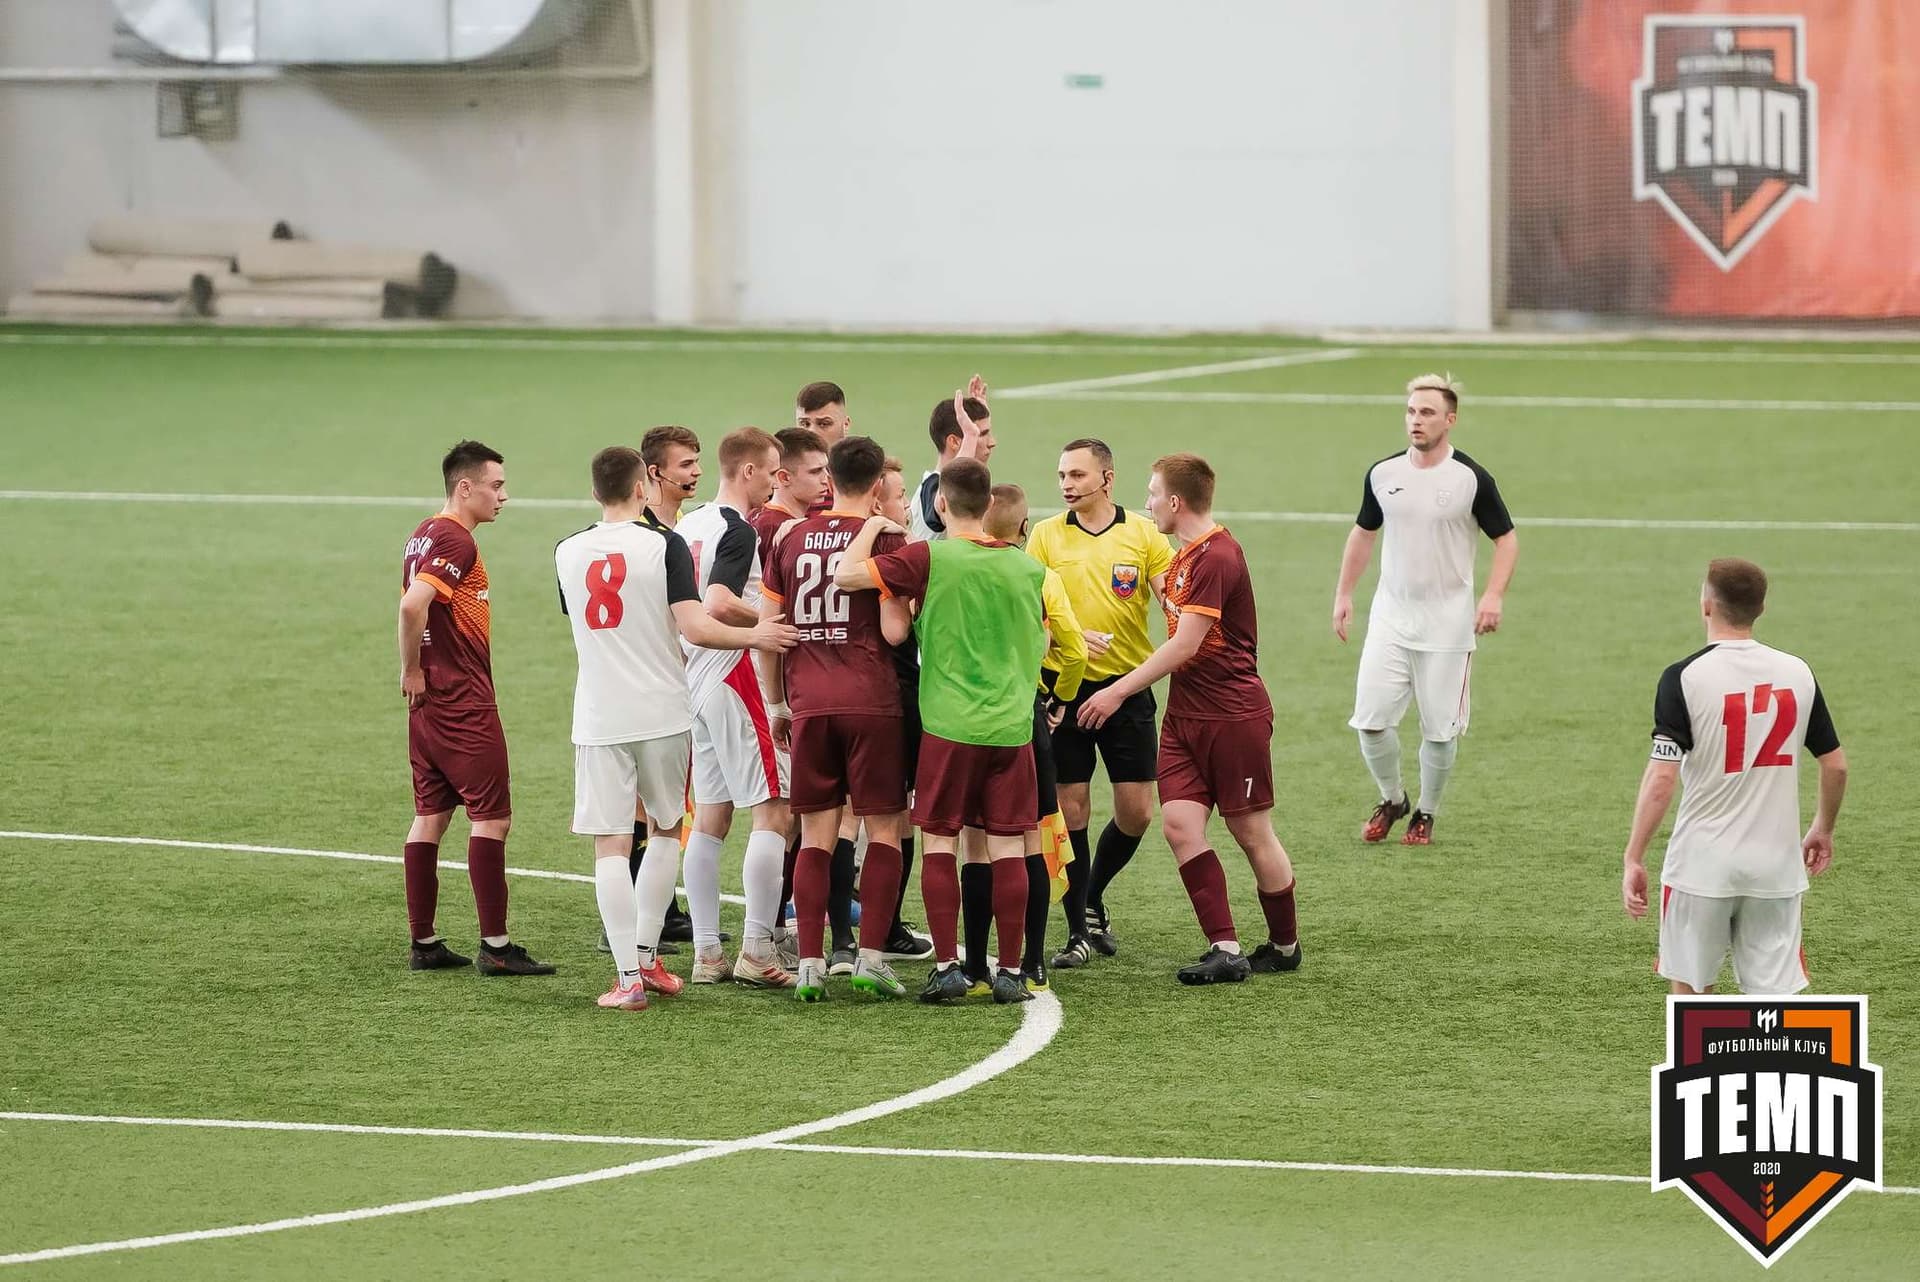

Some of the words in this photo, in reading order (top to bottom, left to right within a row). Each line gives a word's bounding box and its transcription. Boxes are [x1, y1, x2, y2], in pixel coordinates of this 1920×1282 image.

[1650, 86, 1801, 175] ТЕМП
[804, 531, 852, 550] БАБИЧ
[585, 553, 627, 630] 8
[795, 551, 850, 624] 22
[799, 627, 848, 641] SEUS
[1722, 683, 1797, 774] 12
[1244, 777, 1254, 798] 7
